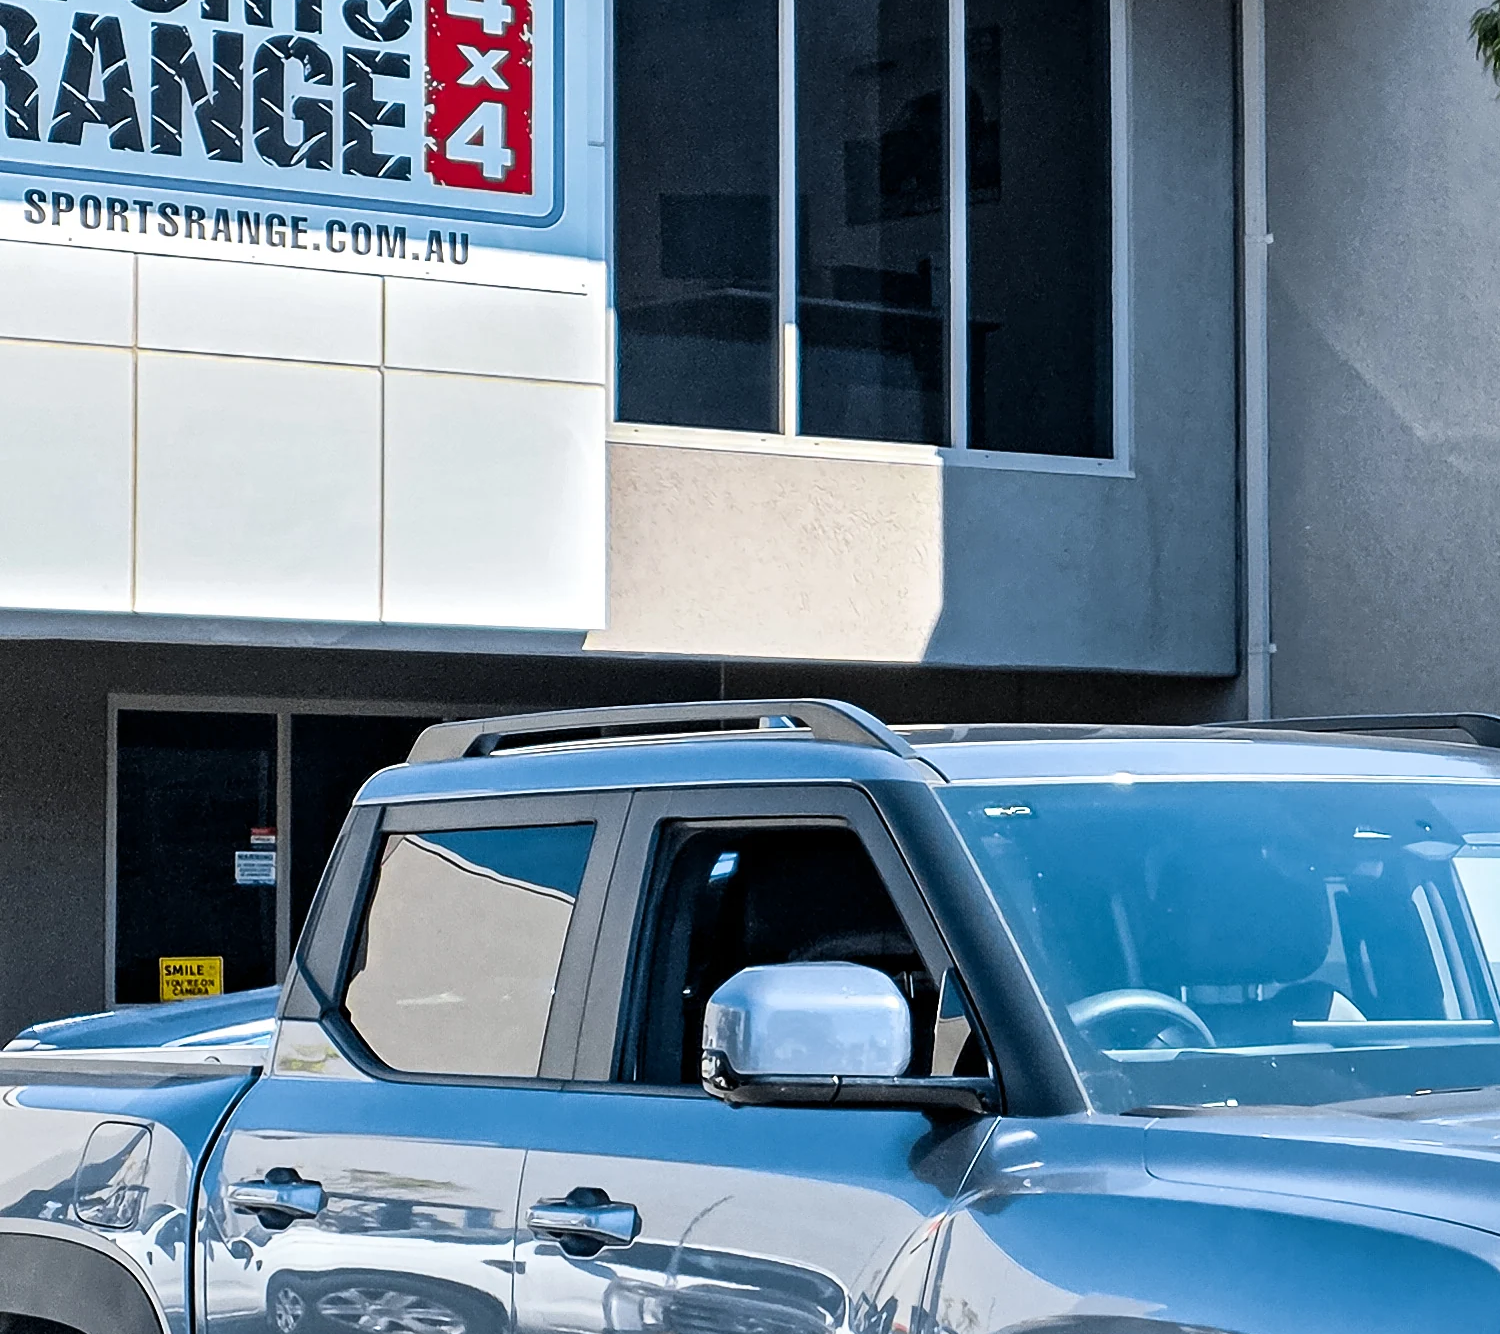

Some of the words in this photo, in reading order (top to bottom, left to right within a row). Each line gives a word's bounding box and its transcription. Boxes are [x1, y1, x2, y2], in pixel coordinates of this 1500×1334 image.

[23, 189, 470, 265] SPORTSRANGE.COM.AU
[164, 964, 205, 976] SMILE
[200, 978, 215, 987] ON
[172, 987, 209, 996] CAMERA
